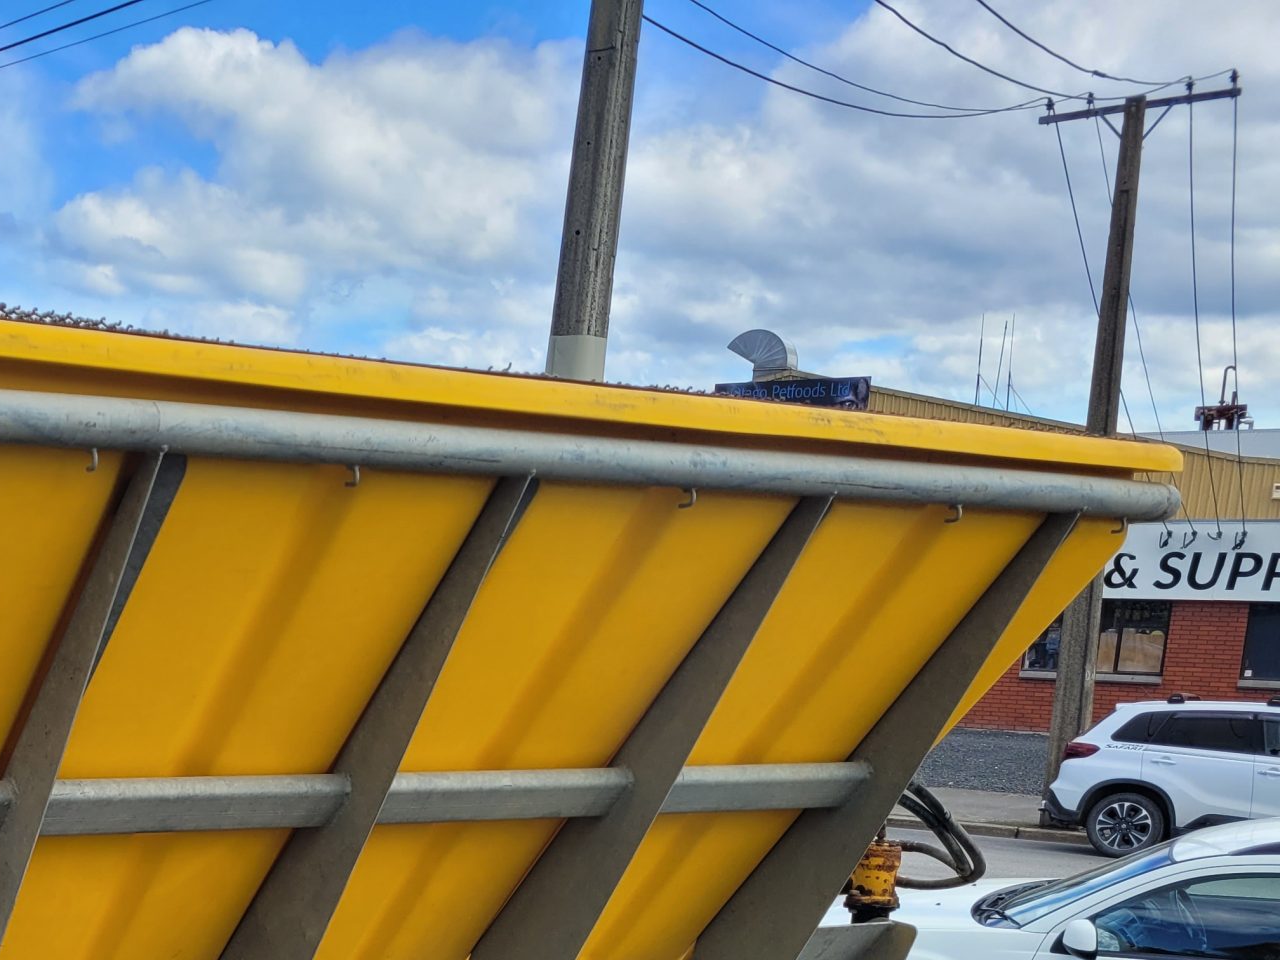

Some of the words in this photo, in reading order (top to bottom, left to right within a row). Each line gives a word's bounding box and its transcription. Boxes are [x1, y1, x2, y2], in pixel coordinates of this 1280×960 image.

[772, 382, 825, 399] Petfoods
[830, 381, 850, 396] Ltd
[1103, 552, 1139, 589] &
